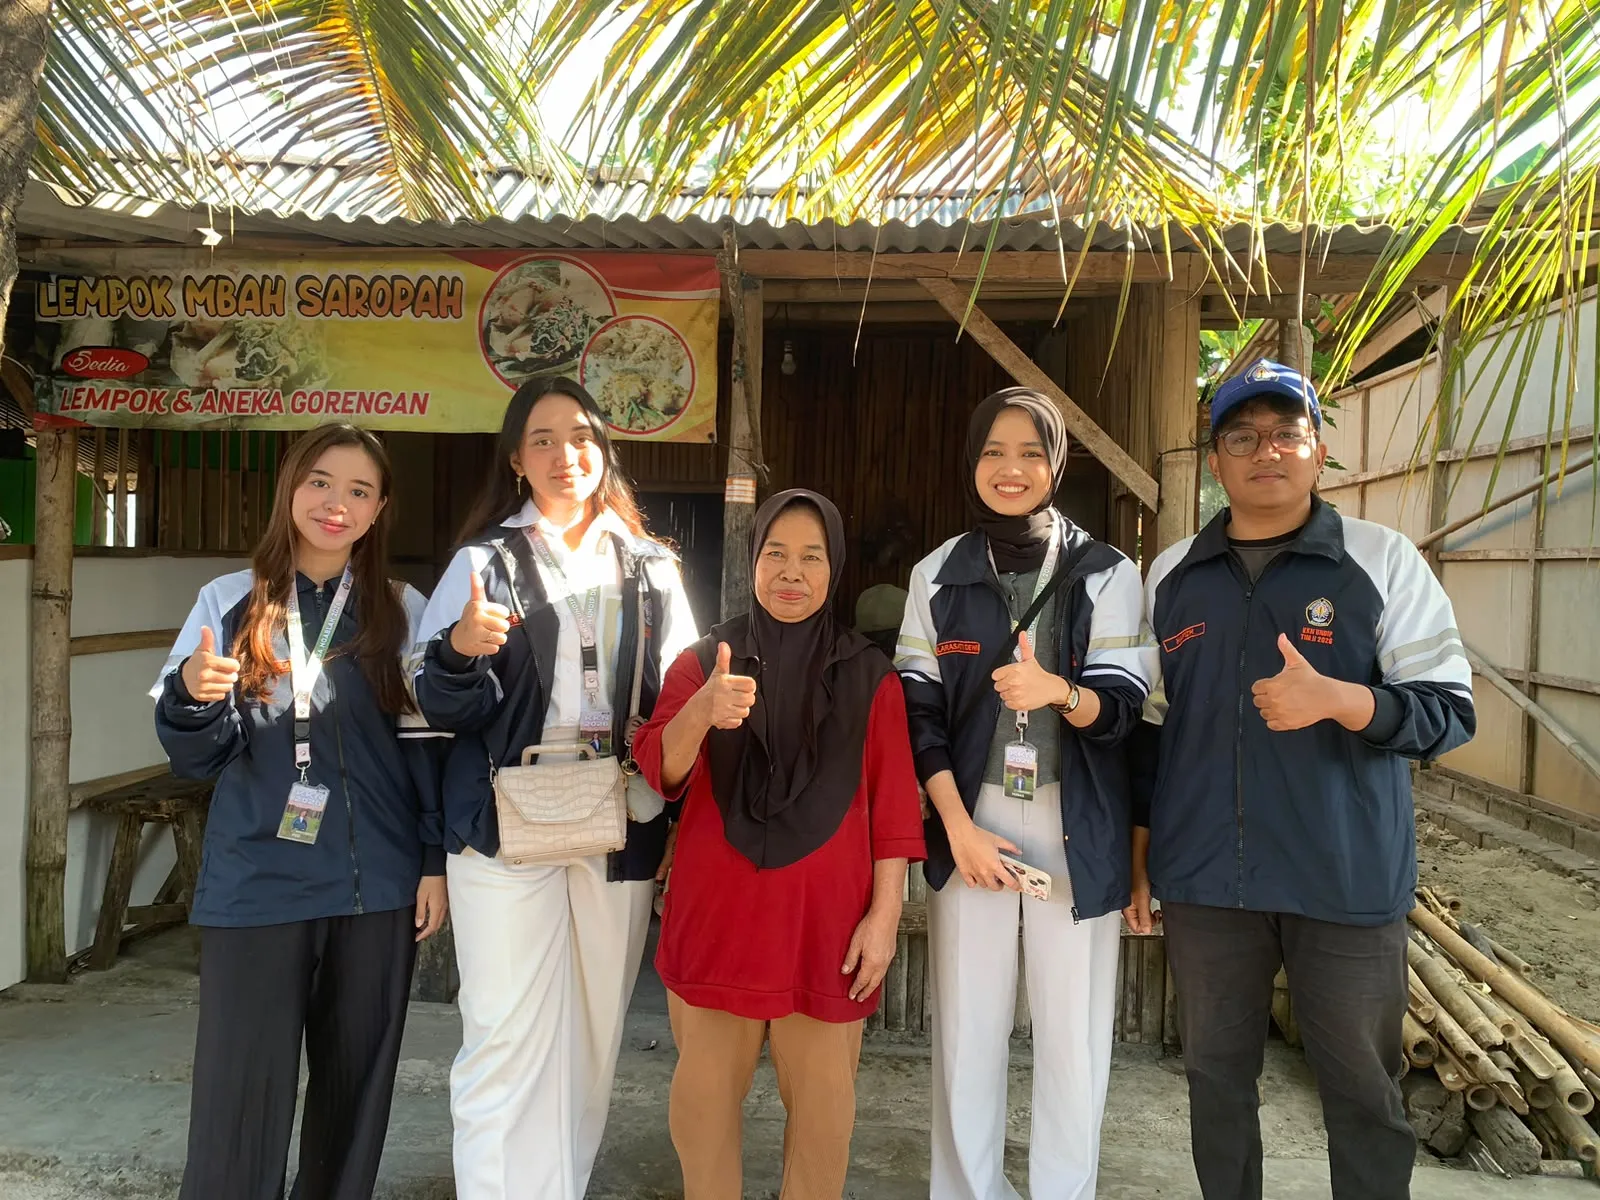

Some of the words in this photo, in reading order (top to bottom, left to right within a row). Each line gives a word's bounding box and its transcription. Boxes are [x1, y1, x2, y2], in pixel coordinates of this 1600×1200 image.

[38, 274, 176, 318] LEMPOK
[182, 274, 286, 318] MBAH
[296, 274, 463, 318] SAROPAH
[68, 350, 130, 373] Sedia
[59, 387, 168, 414] LEMPOK
[172, 390, 194, 413] &
[198, 389, 285, 415] ANEKA
[291, 391, 430, 416] GORENGAN
